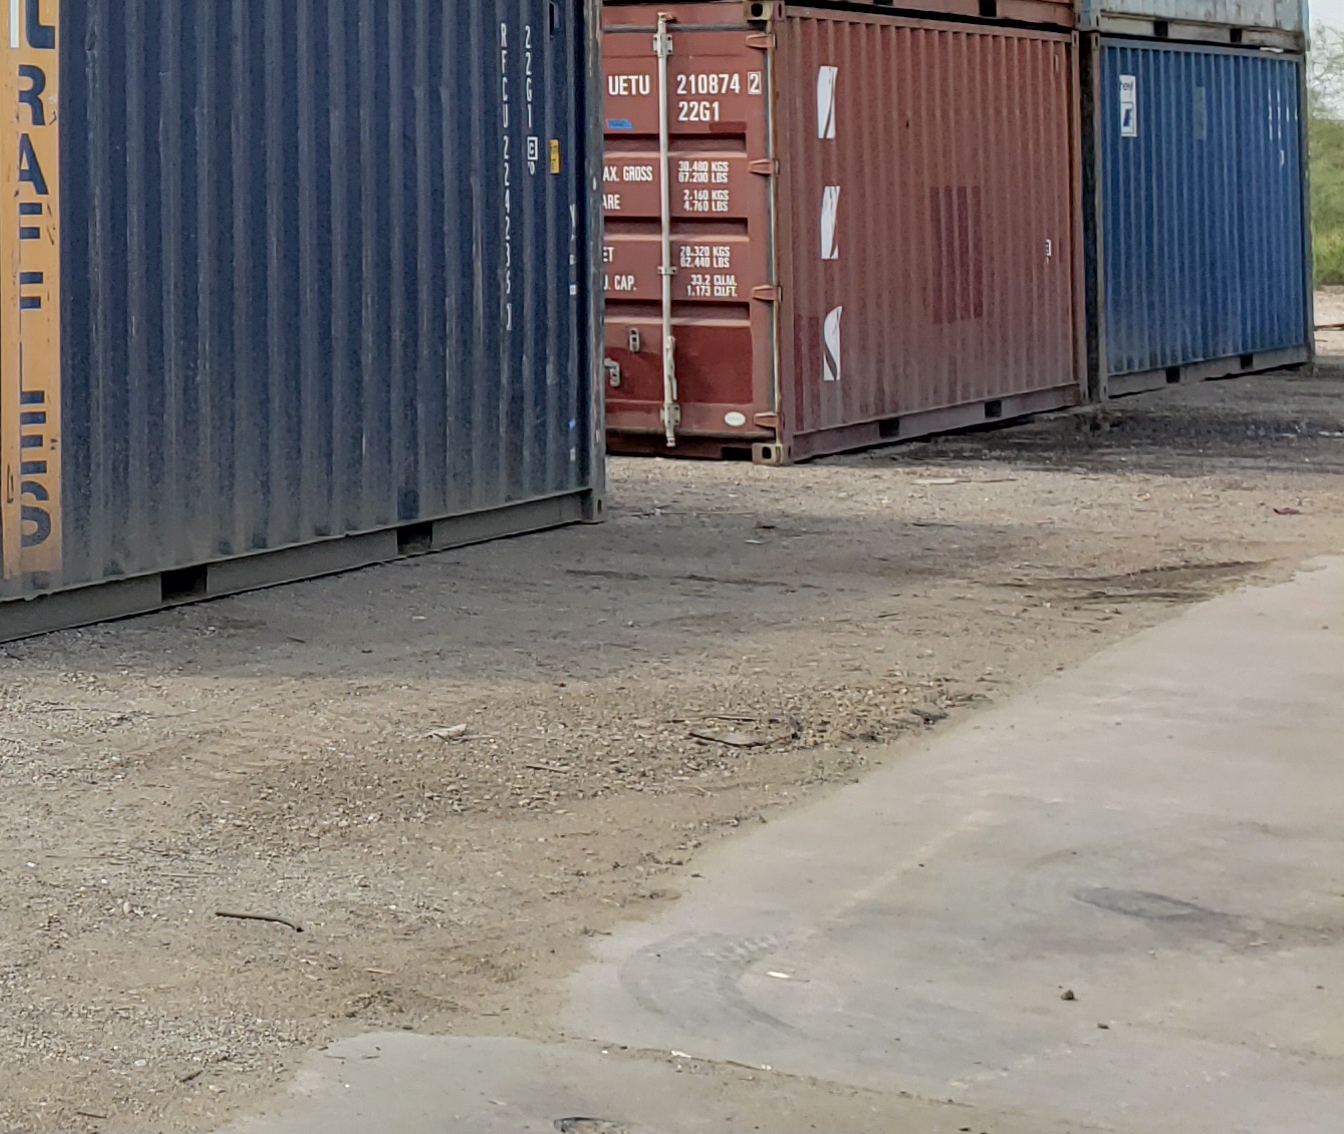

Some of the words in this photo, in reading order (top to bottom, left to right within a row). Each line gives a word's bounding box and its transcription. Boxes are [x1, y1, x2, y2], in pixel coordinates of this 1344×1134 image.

[525, 25, 533, 128] 22G1
[608, 75, 650, 95] UETU
[676, 74, 740, 94] 210874
[749, 72, 760, 93] 2
[678, 102, 720, 121] 22G1
[603, 167, 619, 181] AX.
[623, 166, 653, 181] GROSS
[712, 161, 729, 172] KGS
[712, 172, 728, 183] LBS
[602, 195, 621, 210] ARE
[712, 201, 728, 212] LBS
[603, 246, 616, 262] ET
[614, 274, 638, 291] CAP.
[691, 274, 711, 285] 33.2
